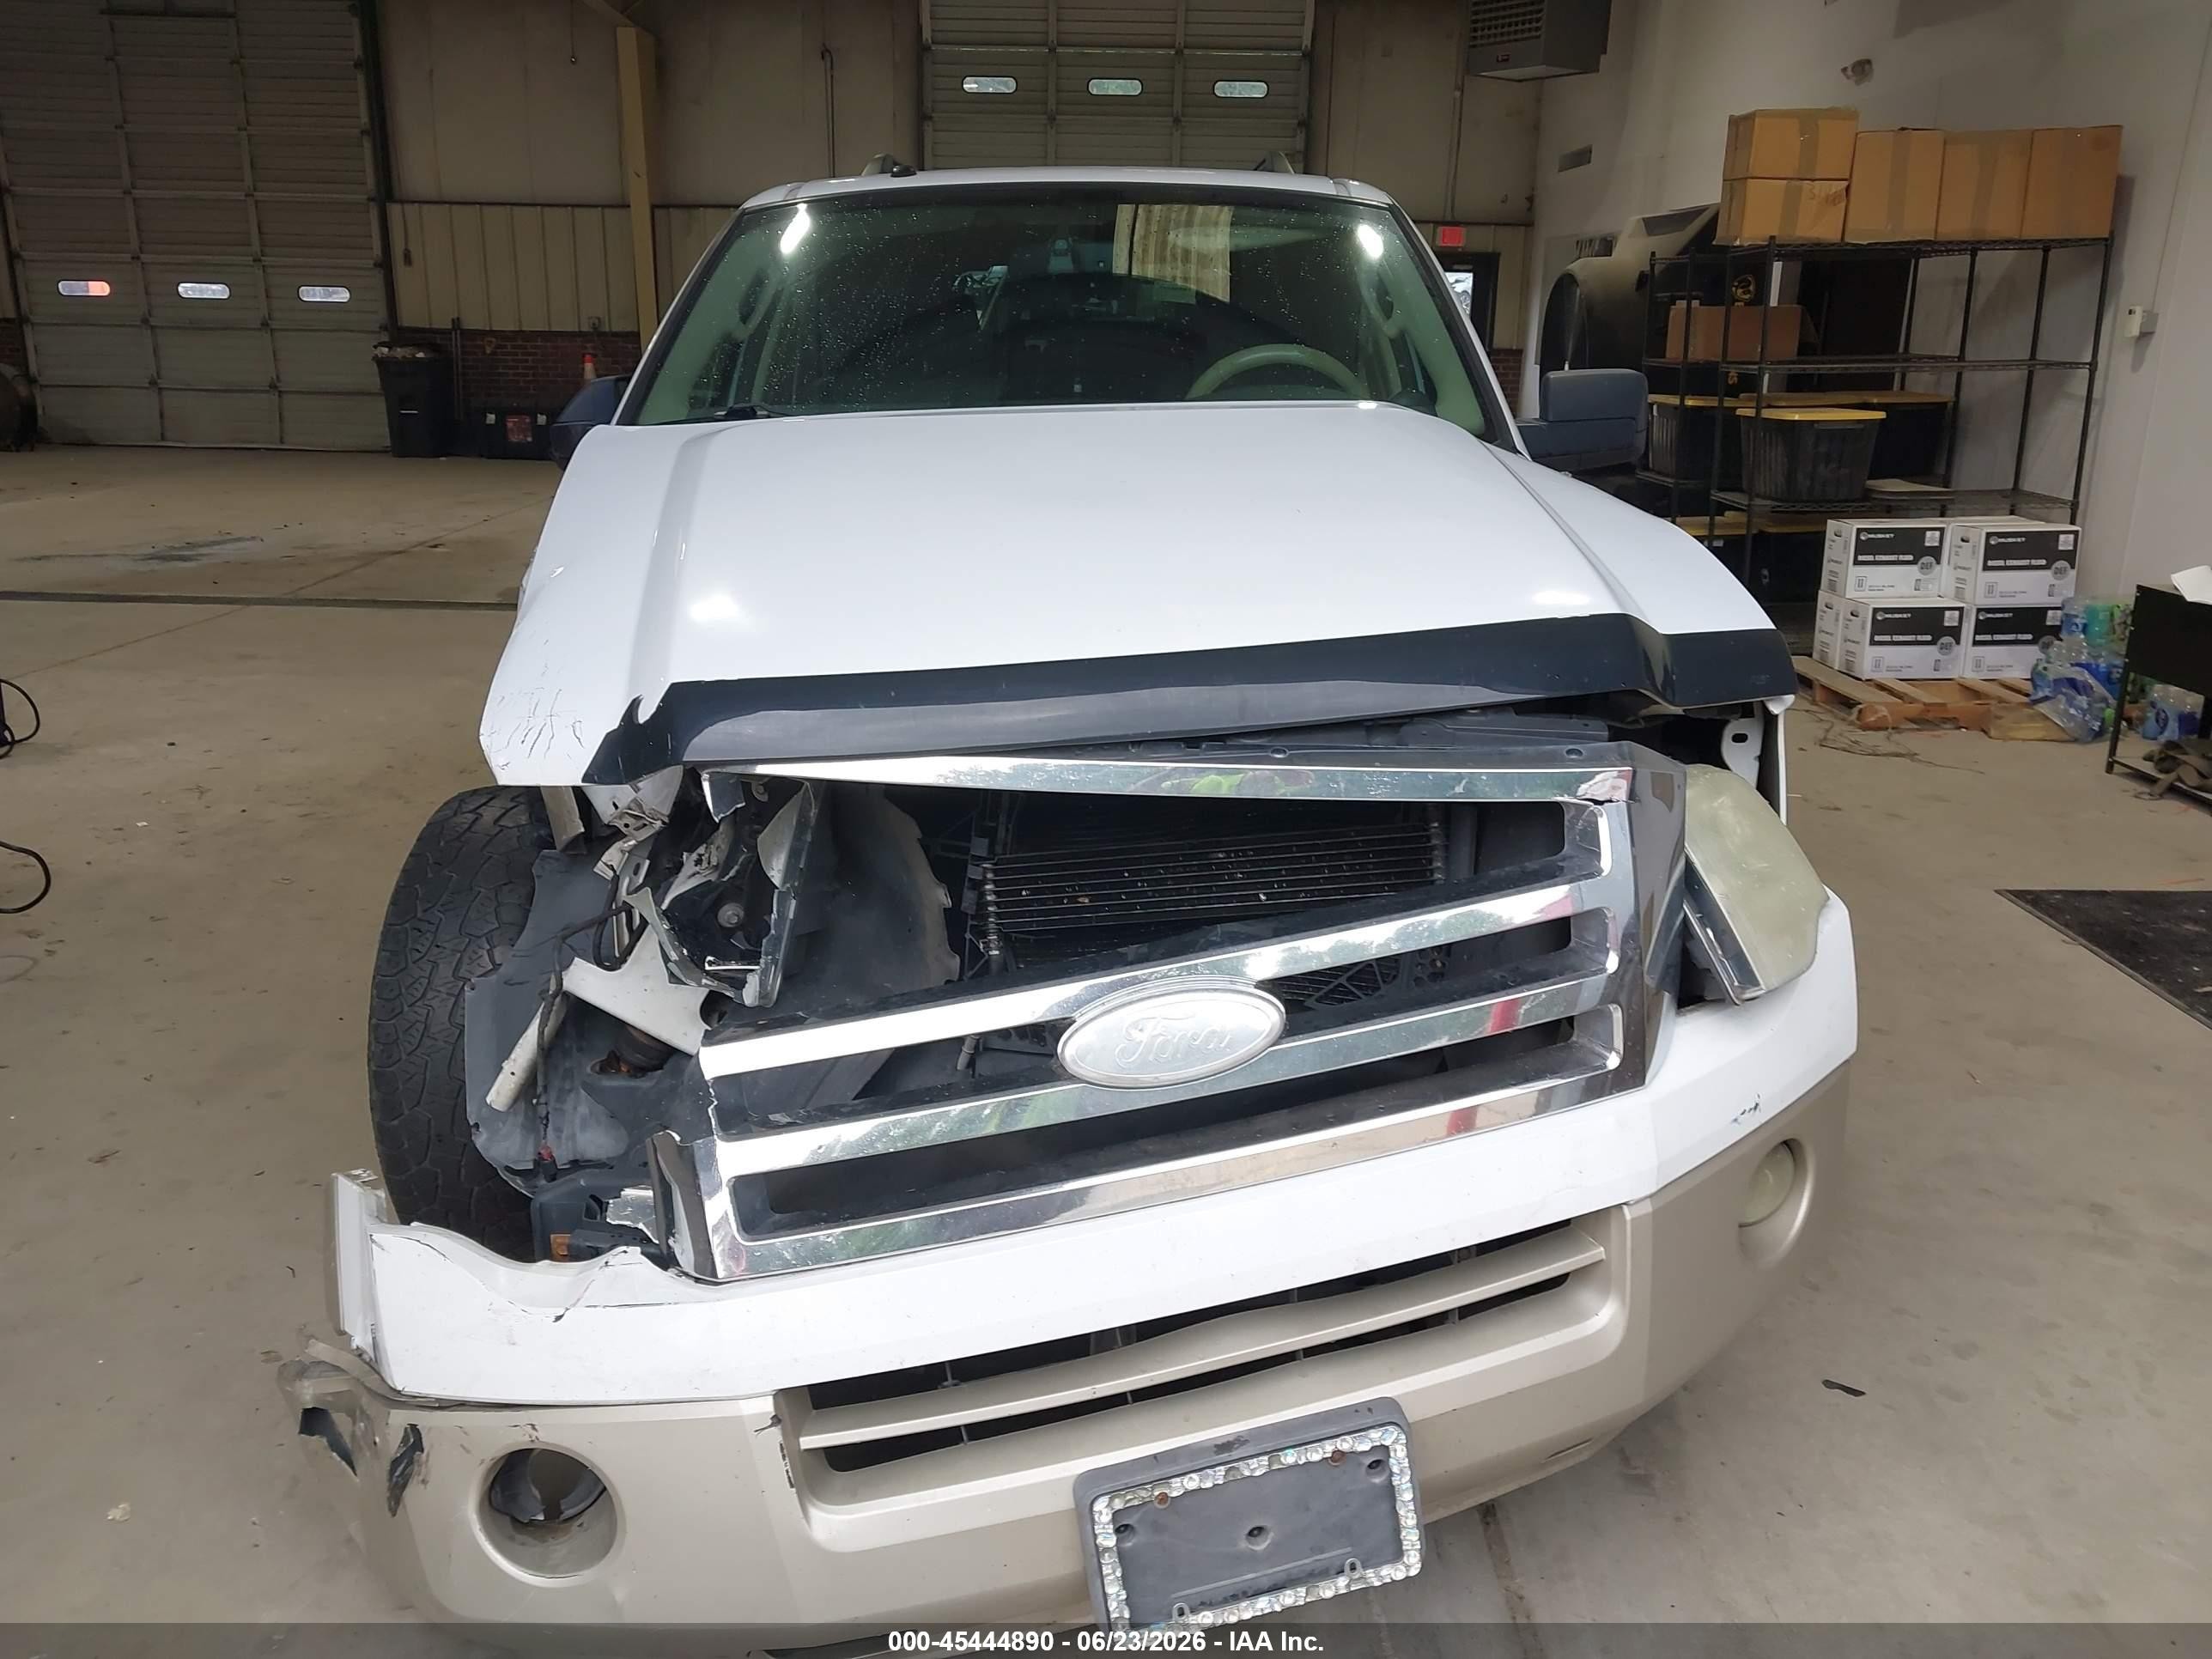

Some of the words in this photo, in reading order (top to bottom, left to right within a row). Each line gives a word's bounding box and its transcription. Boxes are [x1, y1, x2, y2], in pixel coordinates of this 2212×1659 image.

[1919, 562, 1934, 570] DEF
[2053, 566, 2069, 575] DEF
[1939, 641, 1953, 651] DEF
